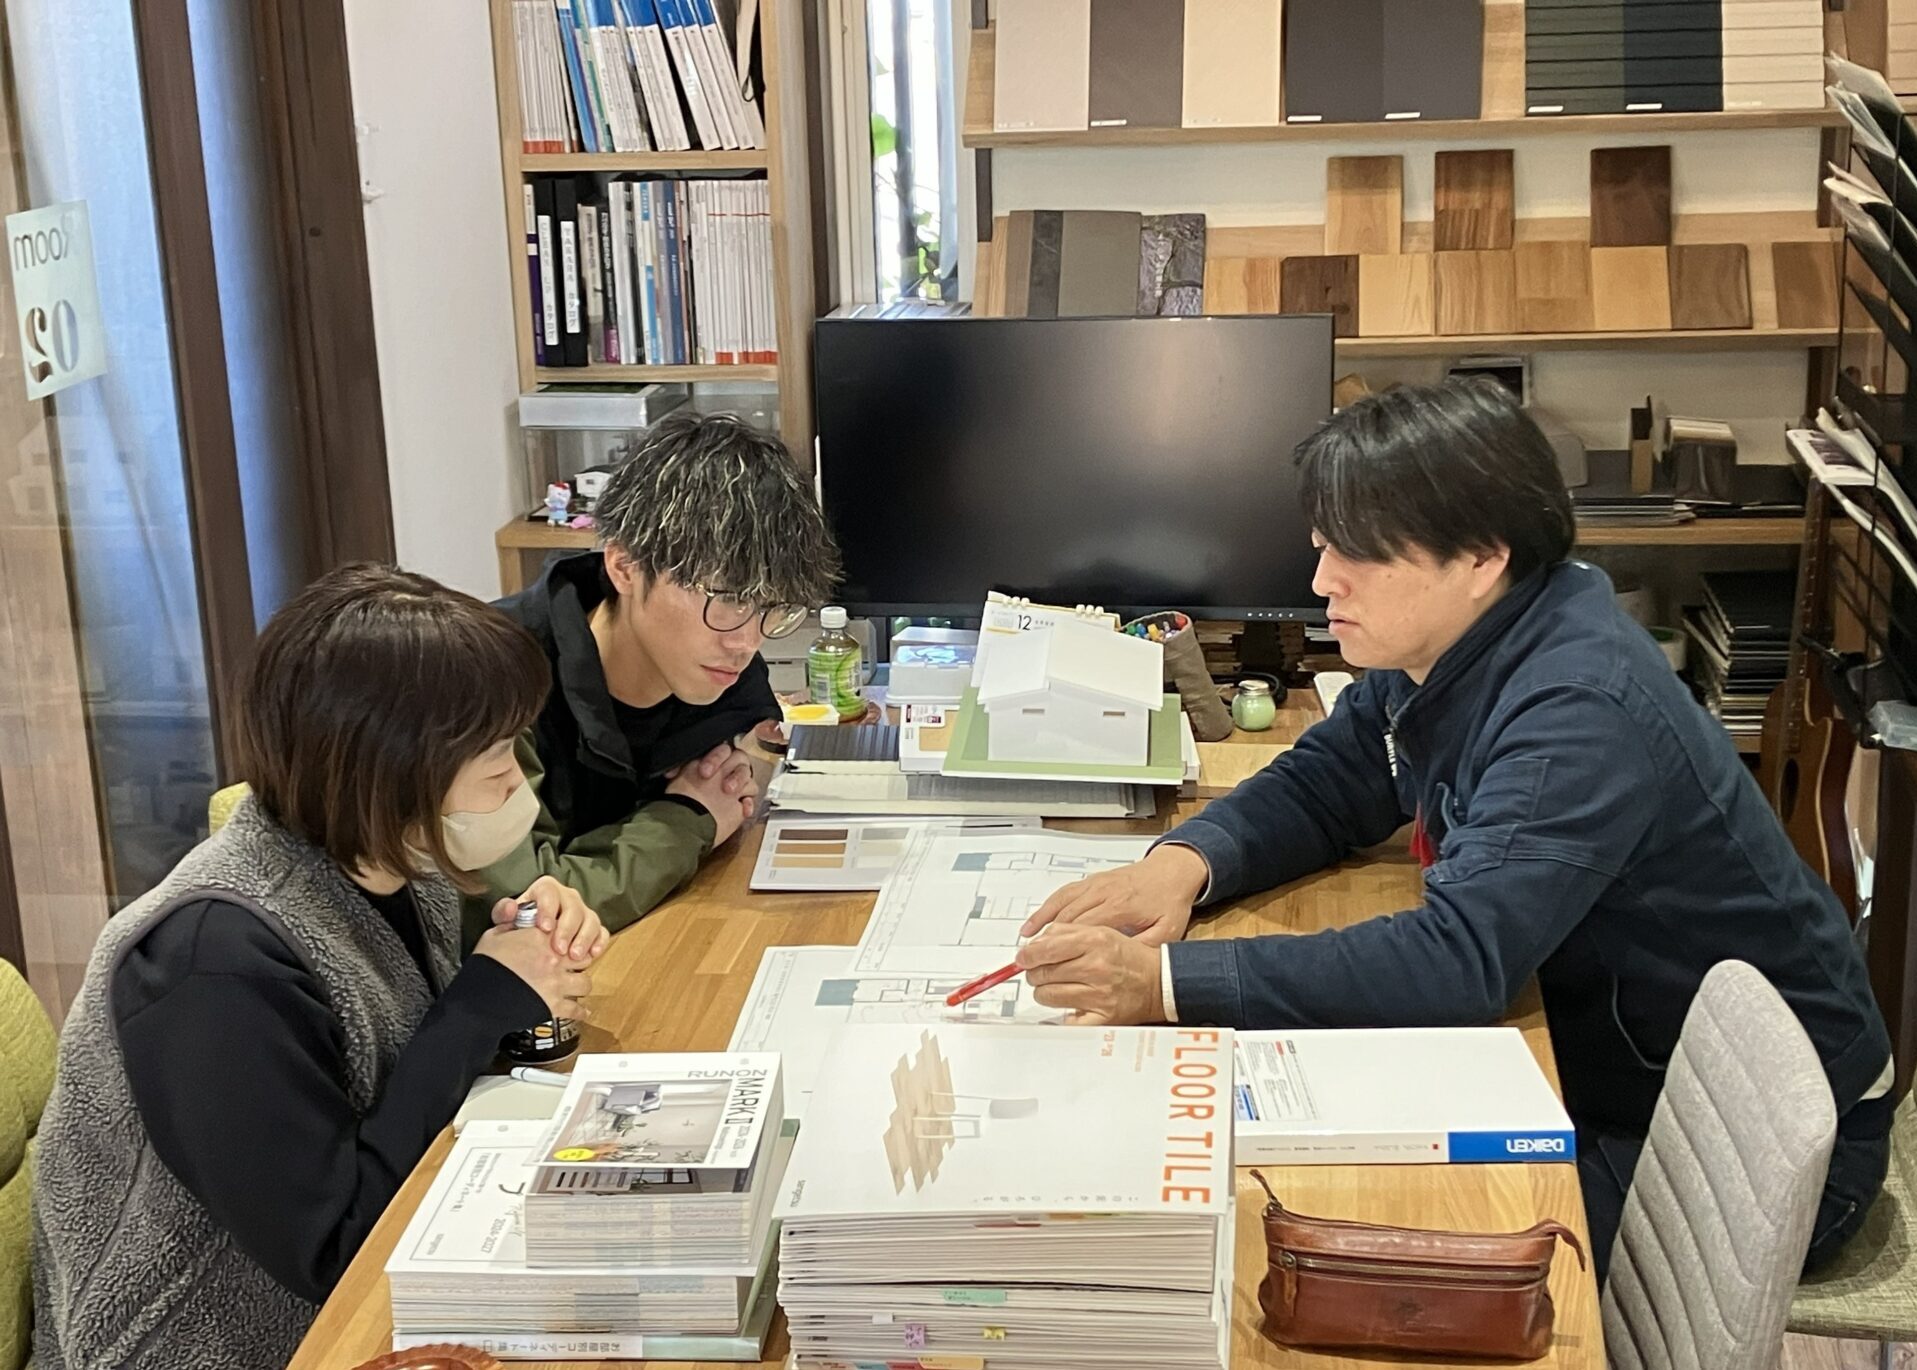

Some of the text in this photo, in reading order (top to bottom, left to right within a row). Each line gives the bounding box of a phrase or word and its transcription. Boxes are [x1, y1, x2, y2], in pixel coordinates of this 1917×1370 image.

[564, 228, 574, 282] TAKARA
[1018, 614, 1032, 631] 12
[687, 1068, 768, 1079] RUNON
[725, 1076, 766, 1116] MARK
[1161, 1030, 1219, 1204] FLOOR TILE
